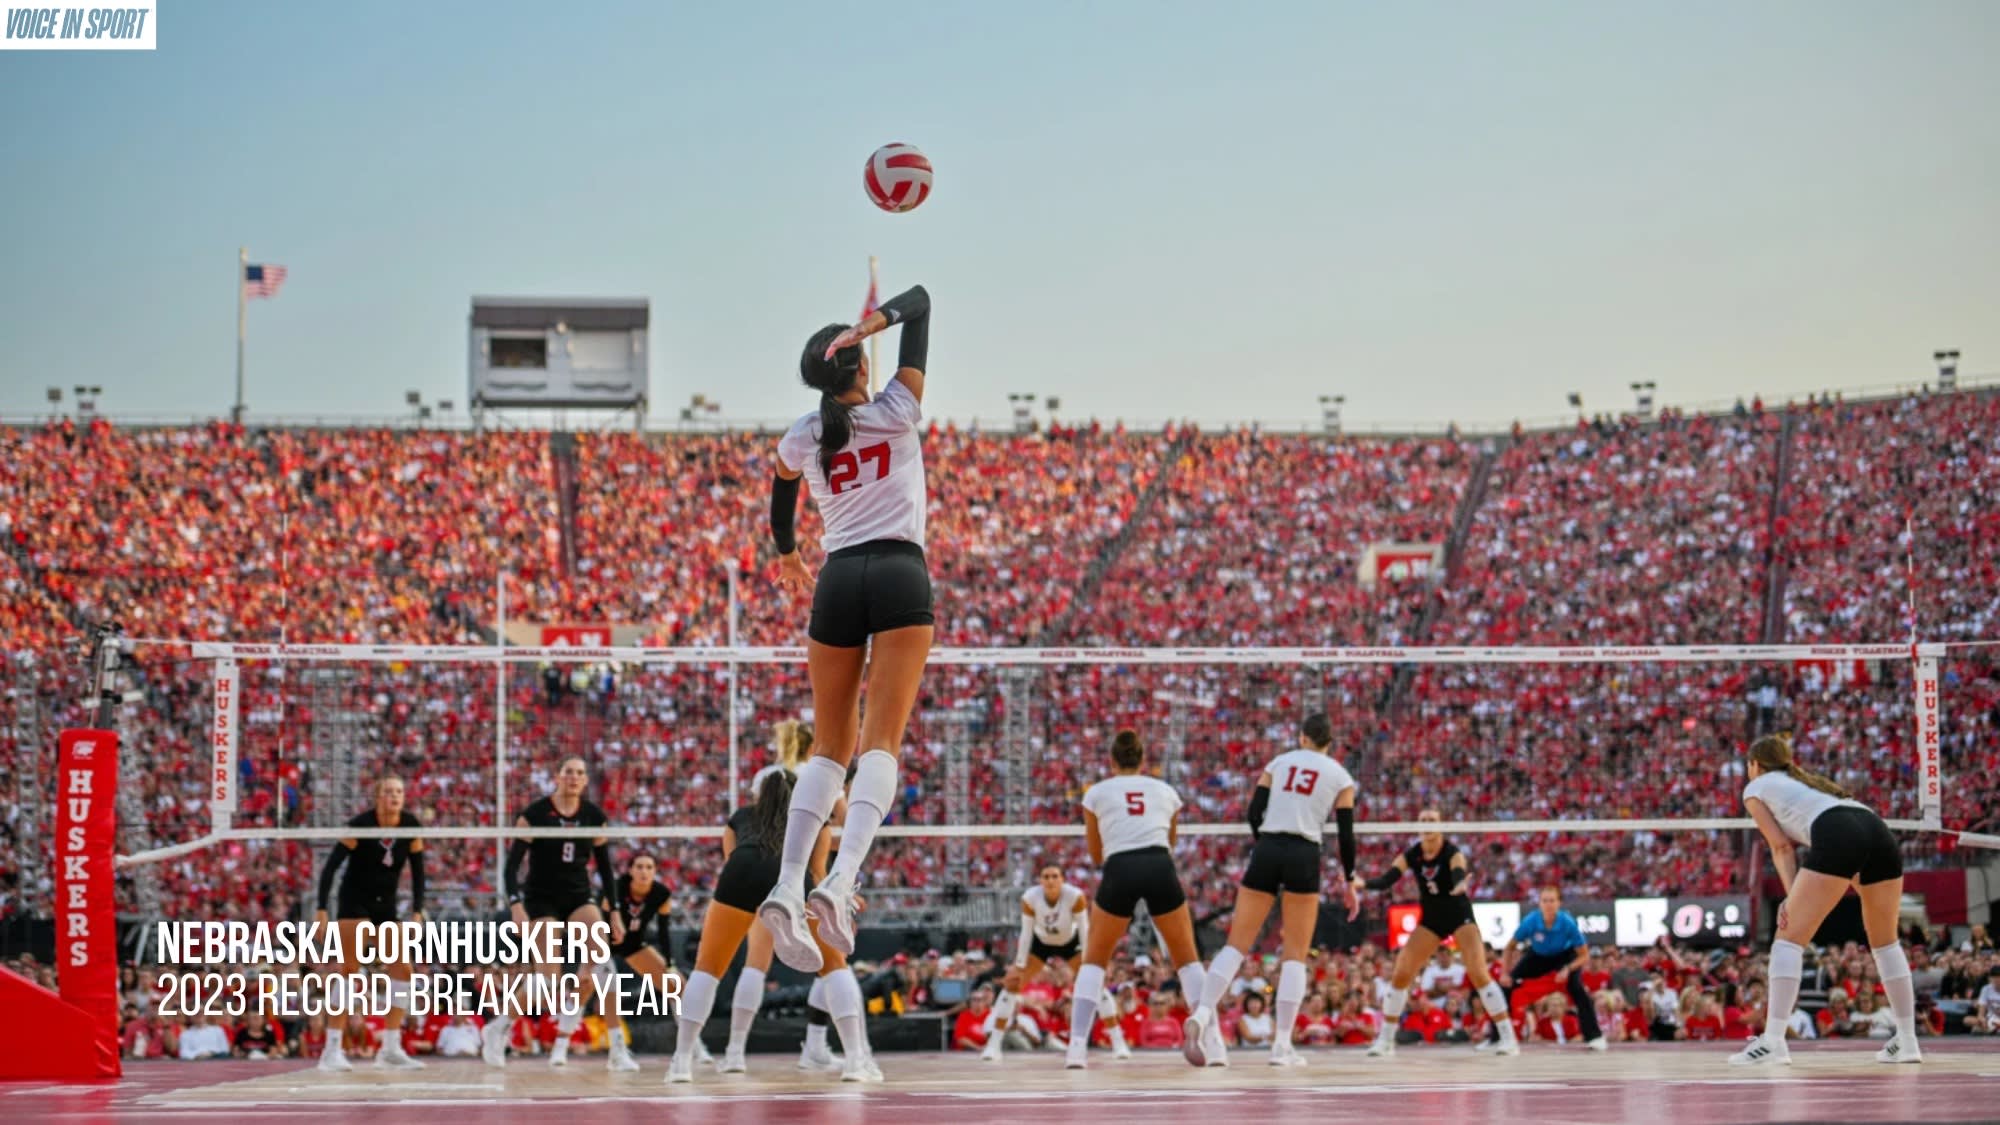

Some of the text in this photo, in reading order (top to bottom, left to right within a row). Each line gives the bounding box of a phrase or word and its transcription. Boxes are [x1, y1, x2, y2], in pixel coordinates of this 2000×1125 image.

[830, 441, 891, 495] 27
[216, 679, 231, 801] HUSKERS
[1924, 680, 1938, 796] HUSKERS
[1125, 792, 1145, 816] 5
[1282, 766, 1319, 796] 13
[64, 769, 94, 967] HUSKERS
[562, 842, 575, 862] 9
